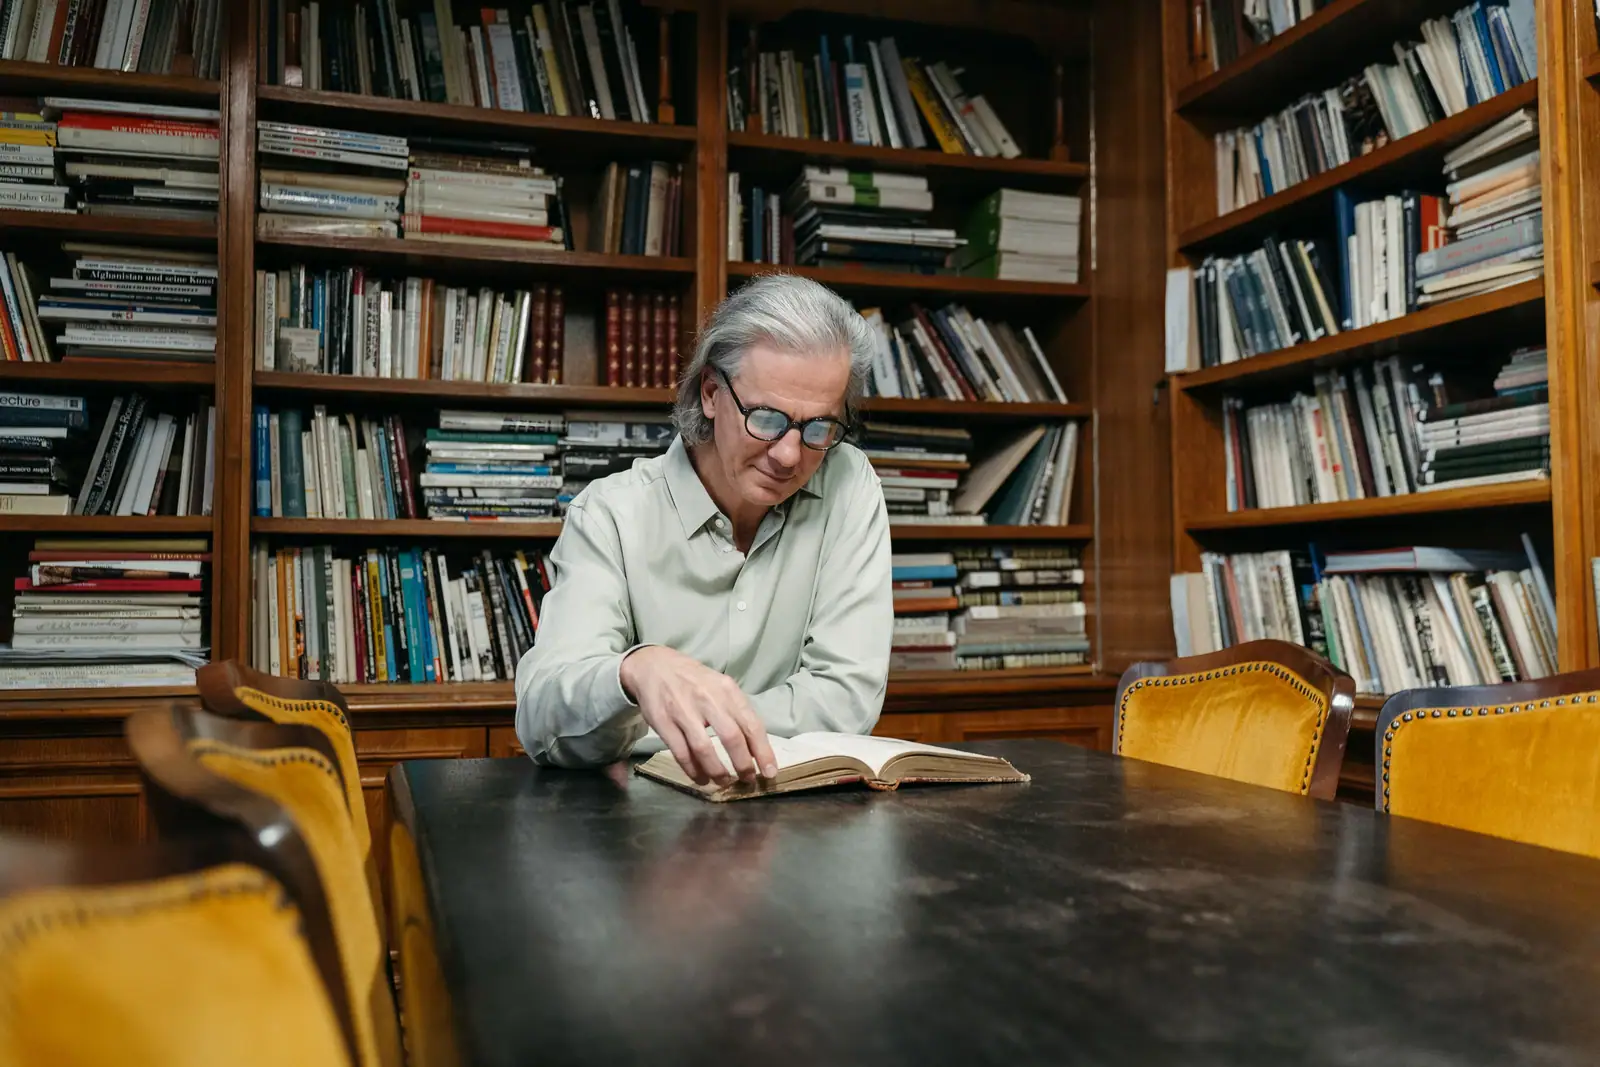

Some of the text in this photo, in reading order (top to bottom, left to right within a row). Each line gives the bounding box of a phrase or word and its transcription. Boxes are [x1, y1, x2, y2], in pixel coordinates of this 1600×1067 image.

[89, 270, 215, 285] Afghanistan und seine Kunst
[0, 395, 41, 407] ecture
